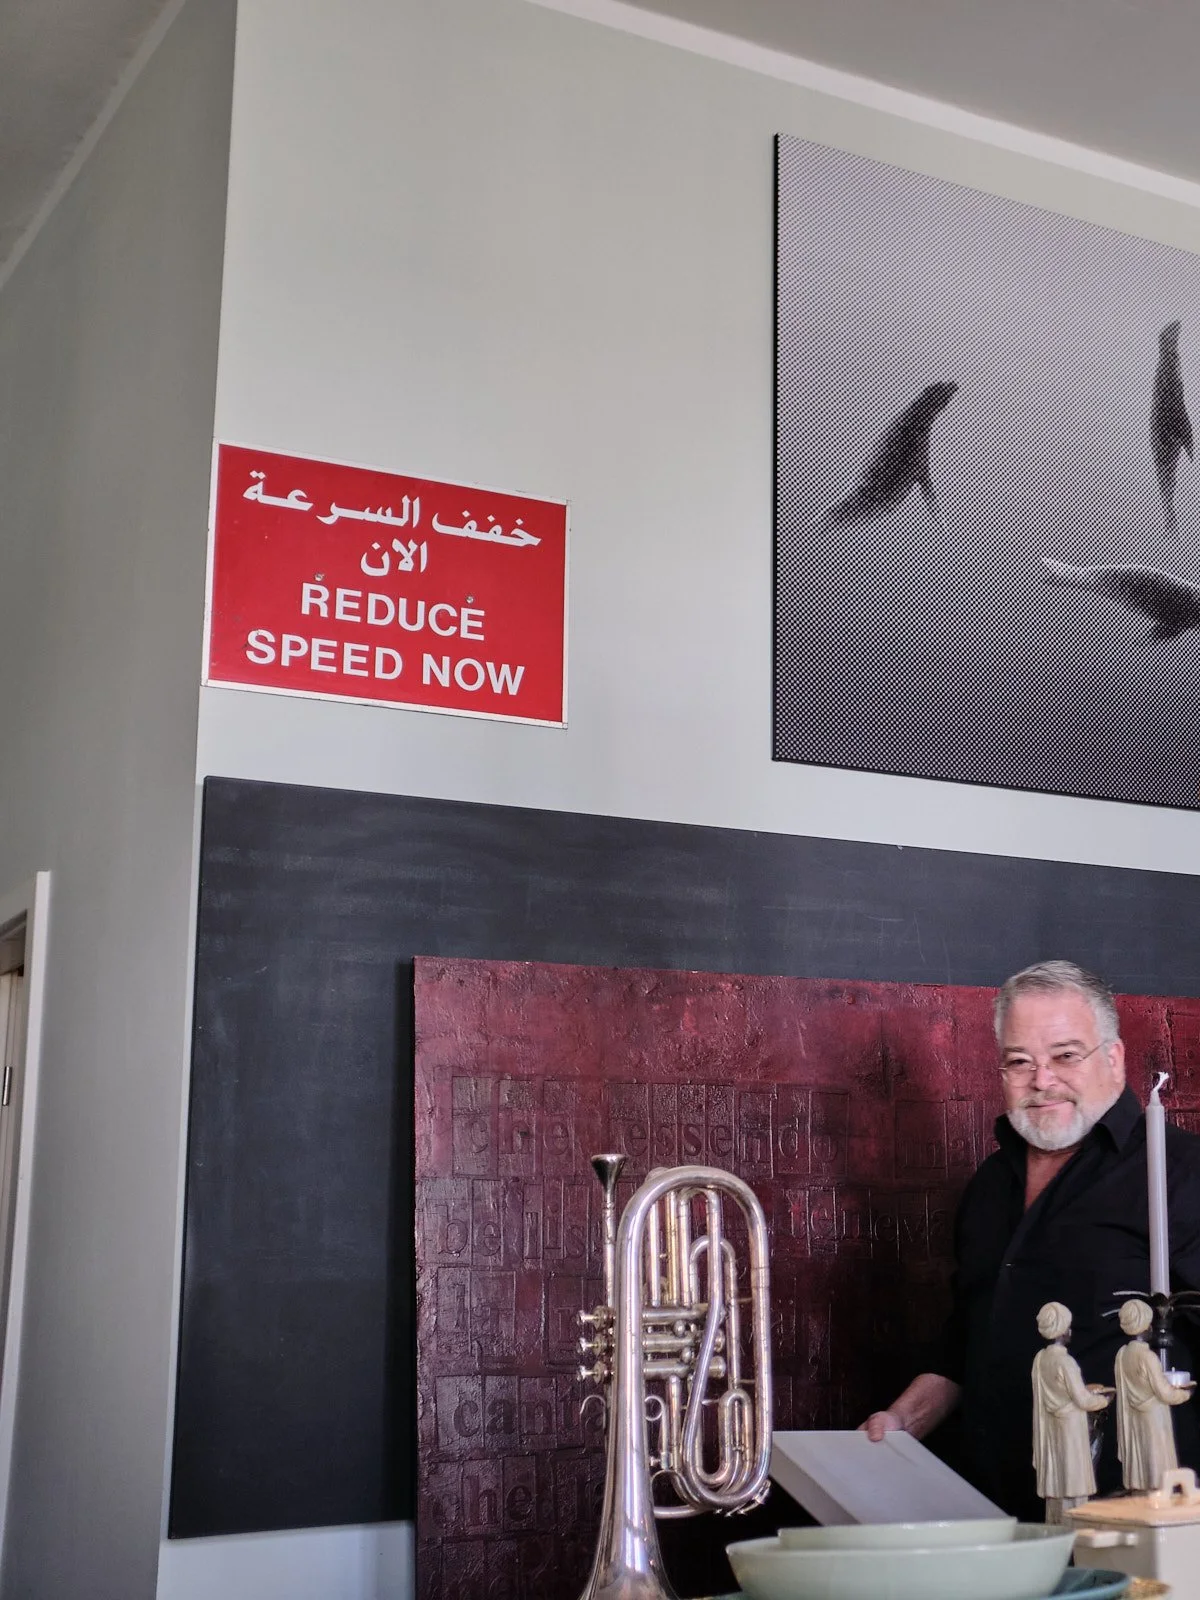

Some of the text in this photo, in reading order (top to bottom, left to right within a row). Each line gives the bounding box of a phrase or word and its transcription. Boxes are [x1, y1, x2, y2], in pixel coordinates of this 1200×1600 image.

[242, 470, 542, 547] خفف السرعة
[301, 582, 485, 641] REDUCE
[245, 629, 525, 696] SPEED NOW
